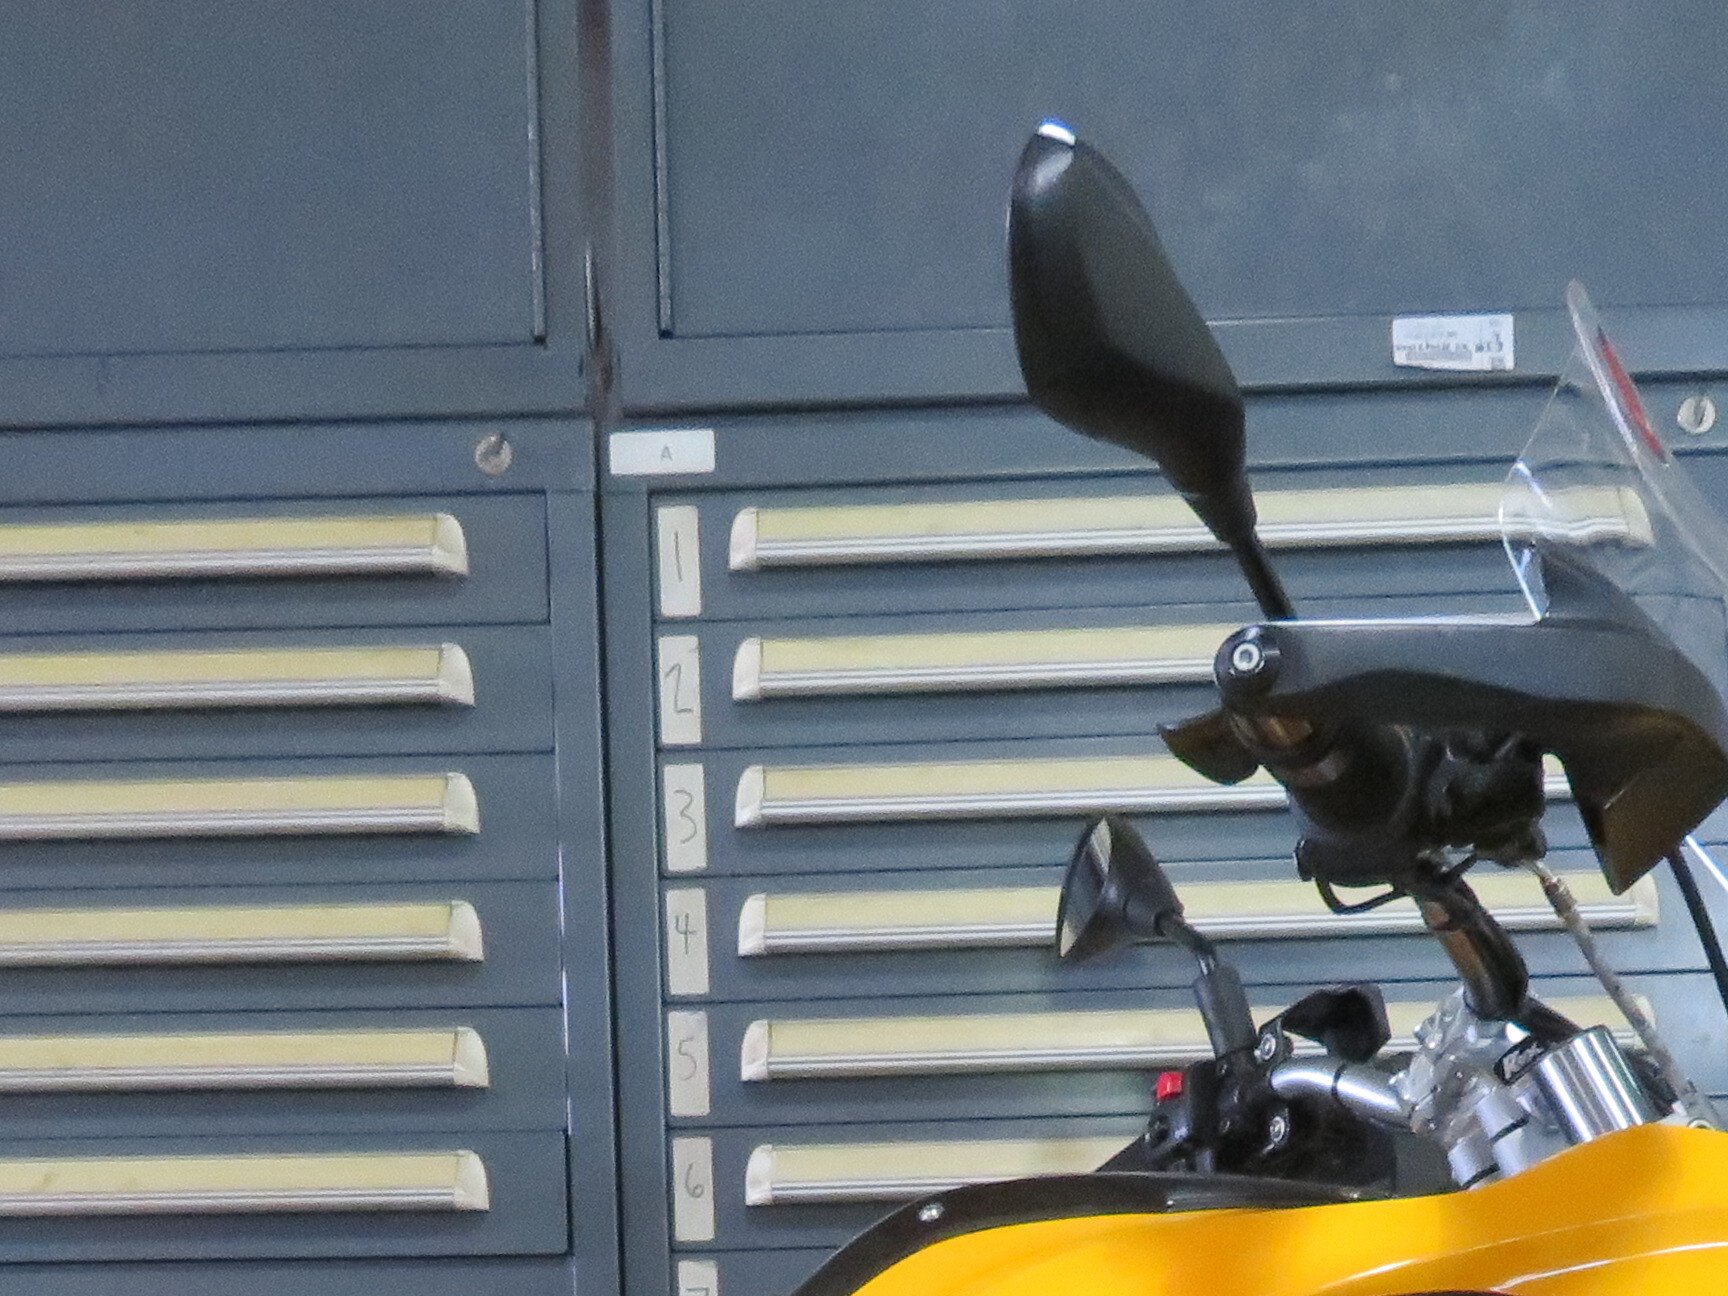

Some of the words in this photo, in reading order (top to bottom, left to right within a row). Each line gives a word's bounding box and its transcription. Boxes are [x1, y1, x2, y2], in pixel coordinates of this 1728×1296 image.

[660, 445, 673, 461] A
[665, 663, 694, 714] 2
[674, 789, 698, 844] 3
[674, 912, 697, 955] 4
[677, 1037, 698, 1081] 5
[685, 1163, 704, 1199] 6
